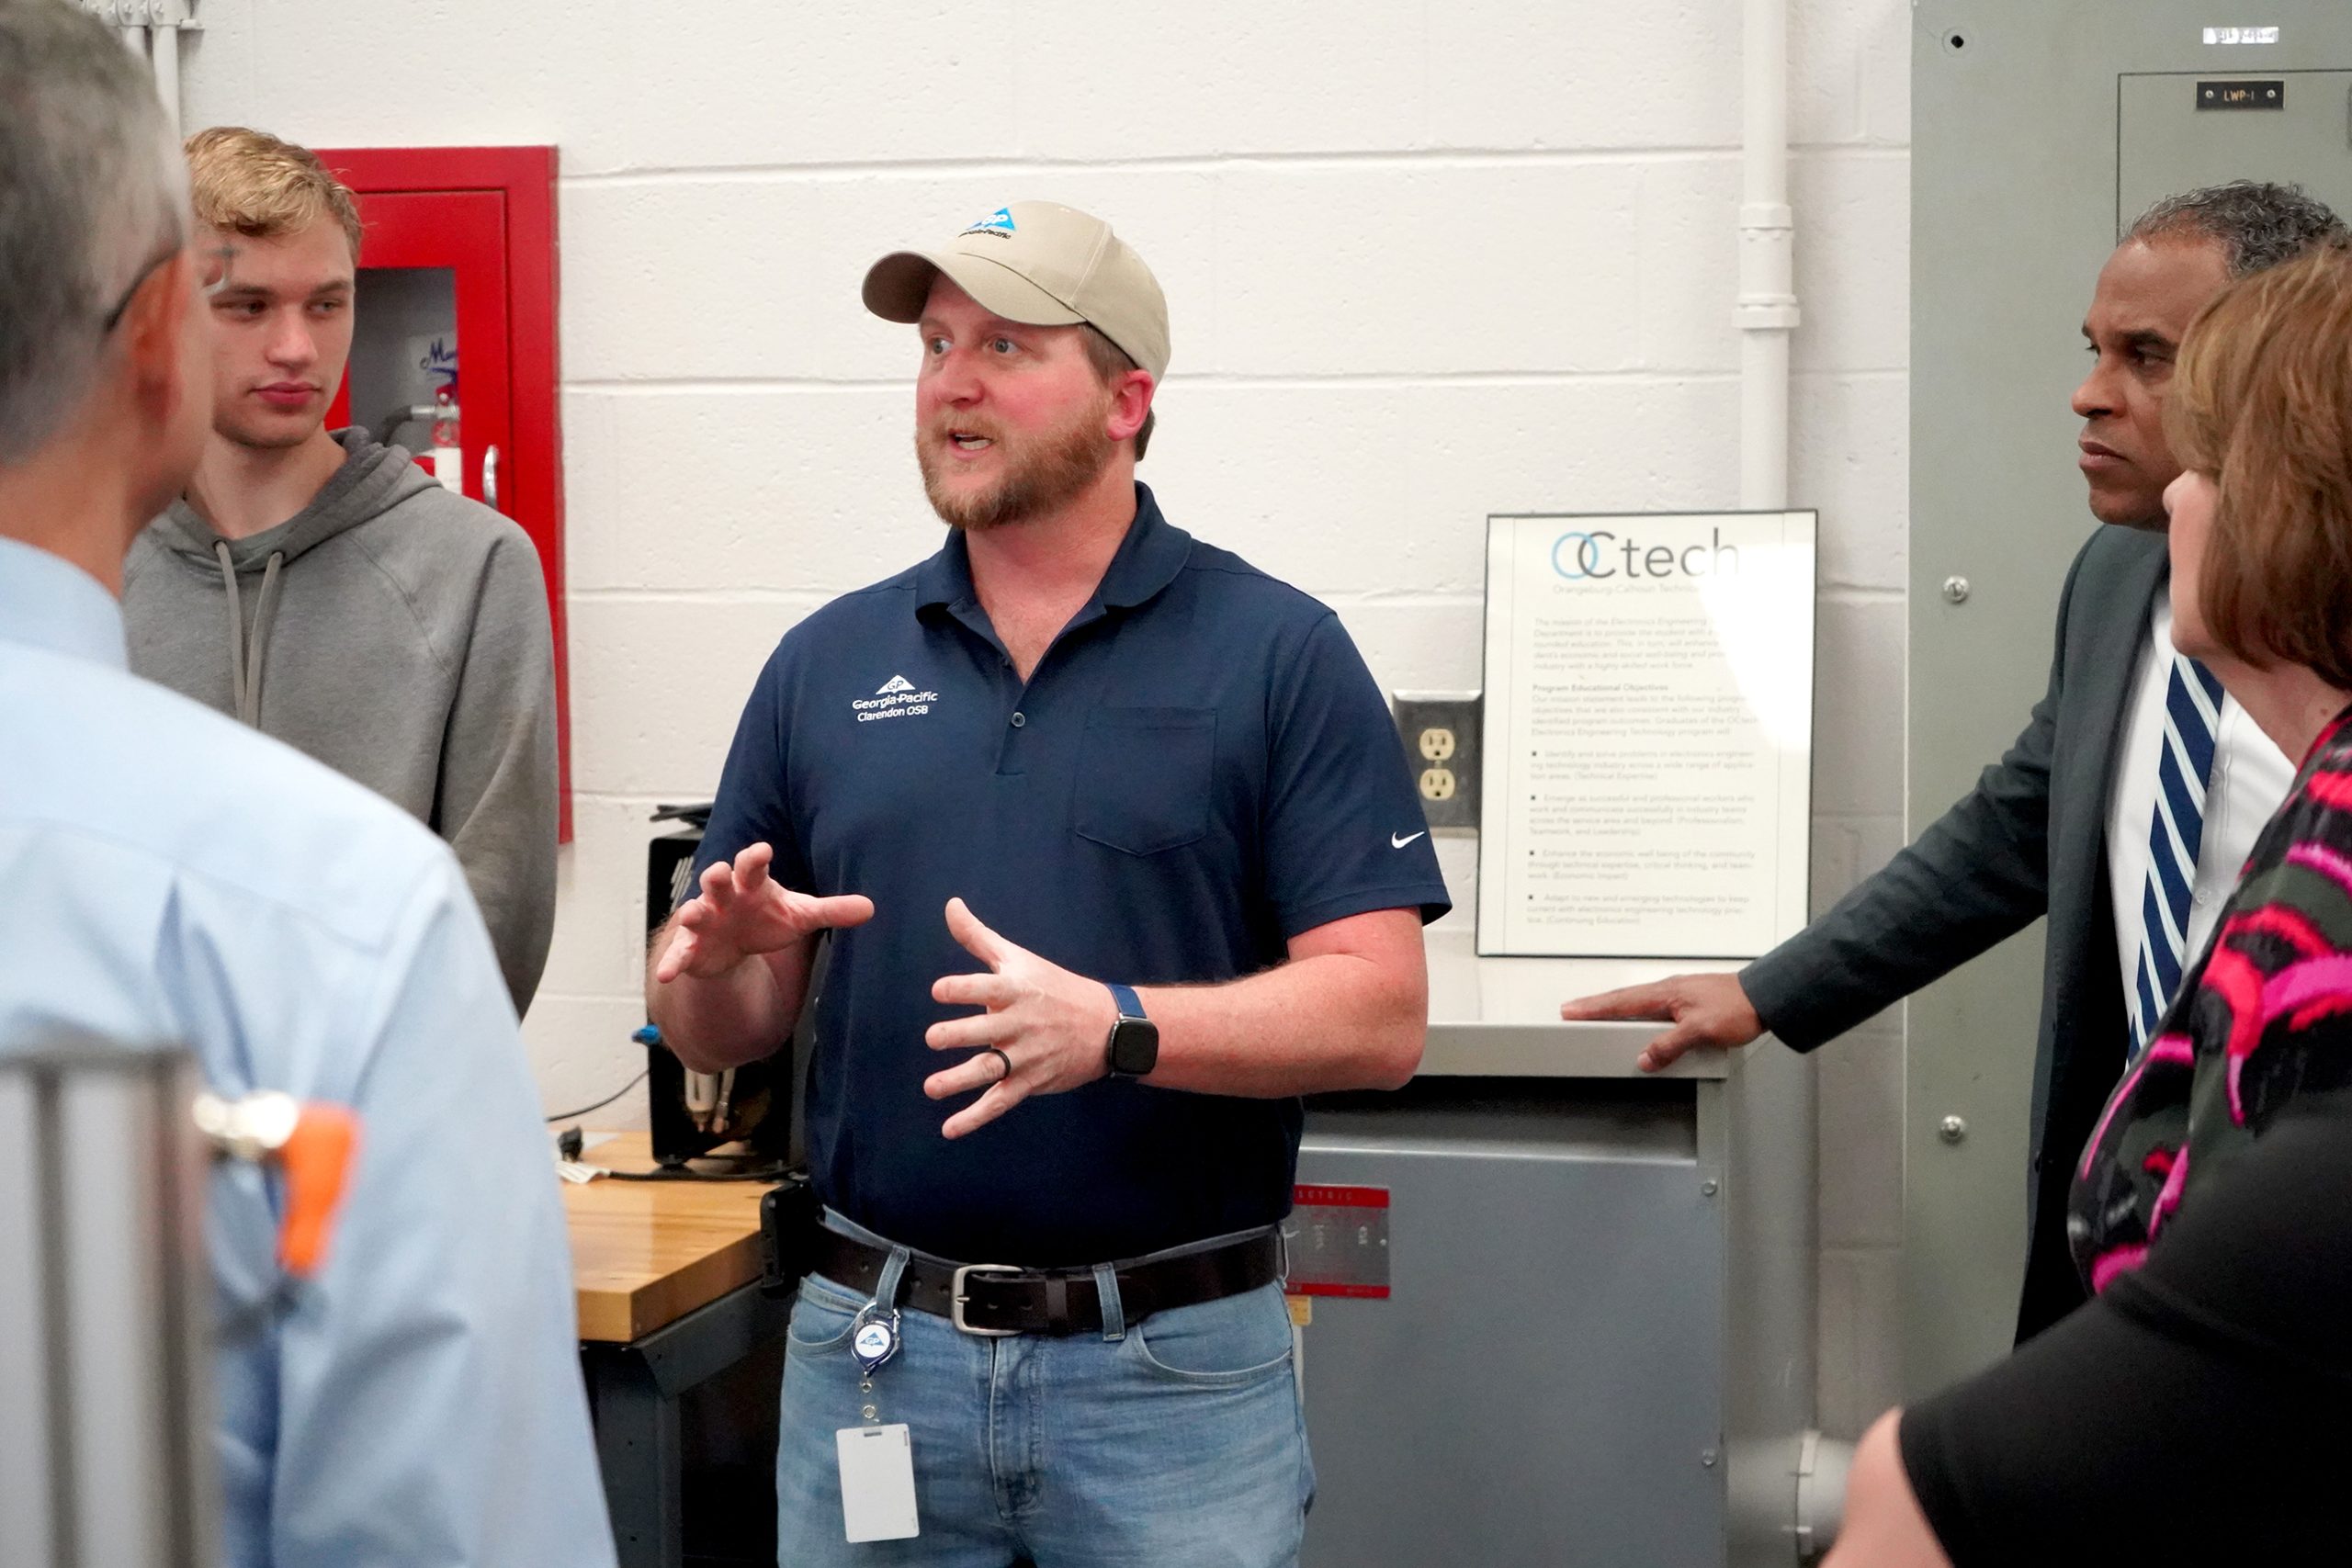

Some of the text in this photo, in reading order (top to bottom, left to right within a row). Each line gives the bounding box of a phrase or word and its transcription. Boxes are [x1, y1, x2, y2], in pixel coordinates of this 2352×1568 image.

[1552, 527, 1739, 580] OCtech
[887, 681, 904, 690] GP
[853, 691, 939, 710] Georgia-Pacific
[857, 705, 929, 722] Clarendon OSB
